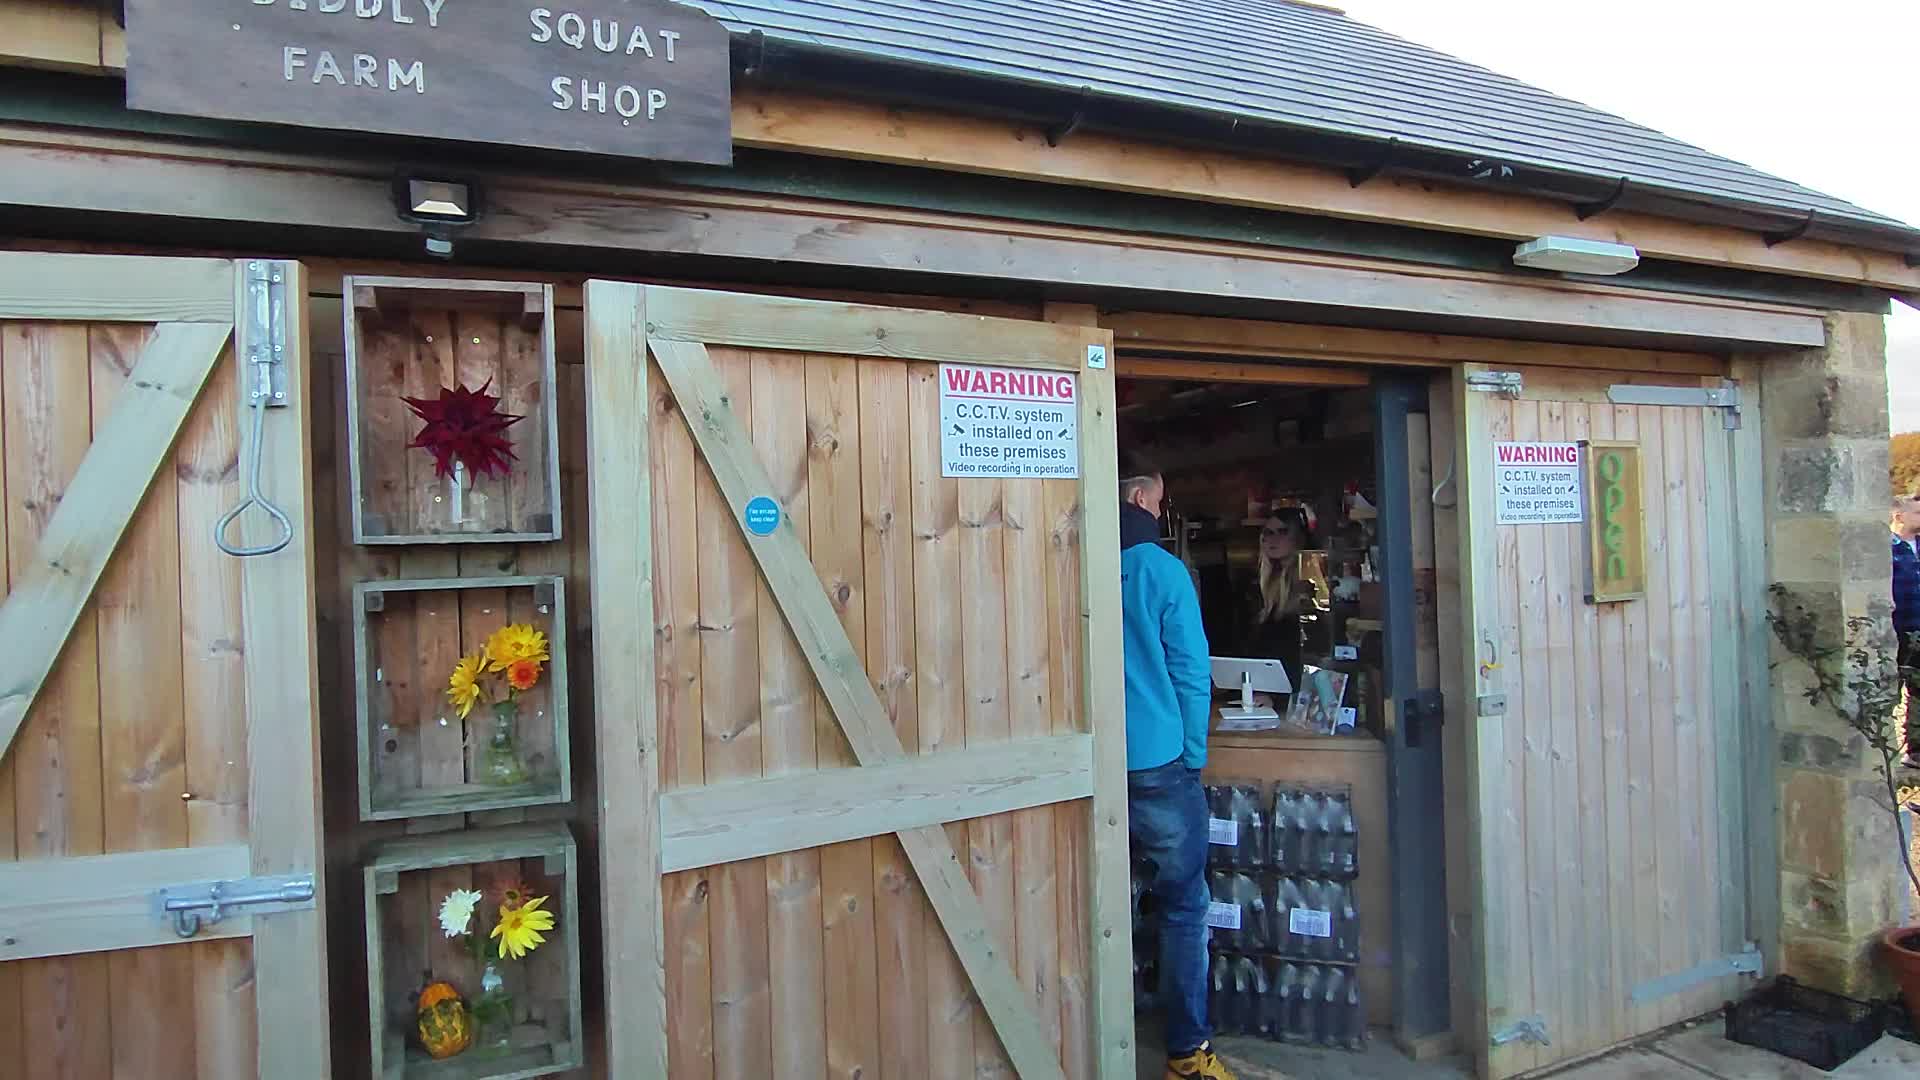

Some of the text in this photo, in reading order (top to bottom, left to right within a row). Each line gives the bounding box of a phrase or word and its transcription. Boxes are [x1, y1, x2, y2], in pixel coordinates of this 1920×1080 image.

[529, 8, 681, 62] SQUAT
[283, 45, 668, 120] FARM SHOP
[946, 368, 1073, 398] WARNING
[956, 403, 1063, 424] C.C.T.V. system
[972, 424, 1053, 441] installed on
[959, 443, 1066, 461] these premises
[1498, 446, 1577, 463] WARNING
[948, 462, 1075, 475] Video recording in operation
[1504, 470, 1571, 484] C.C.T.V. system
[1514, 484, 1566, 495] installed on
[1506, 498, 1574, 511] these premises
[1500, 512, 1517, 521] Video
[1518, 512, 1546, 521] recording
[1553, 511, 1580, 520] operation
